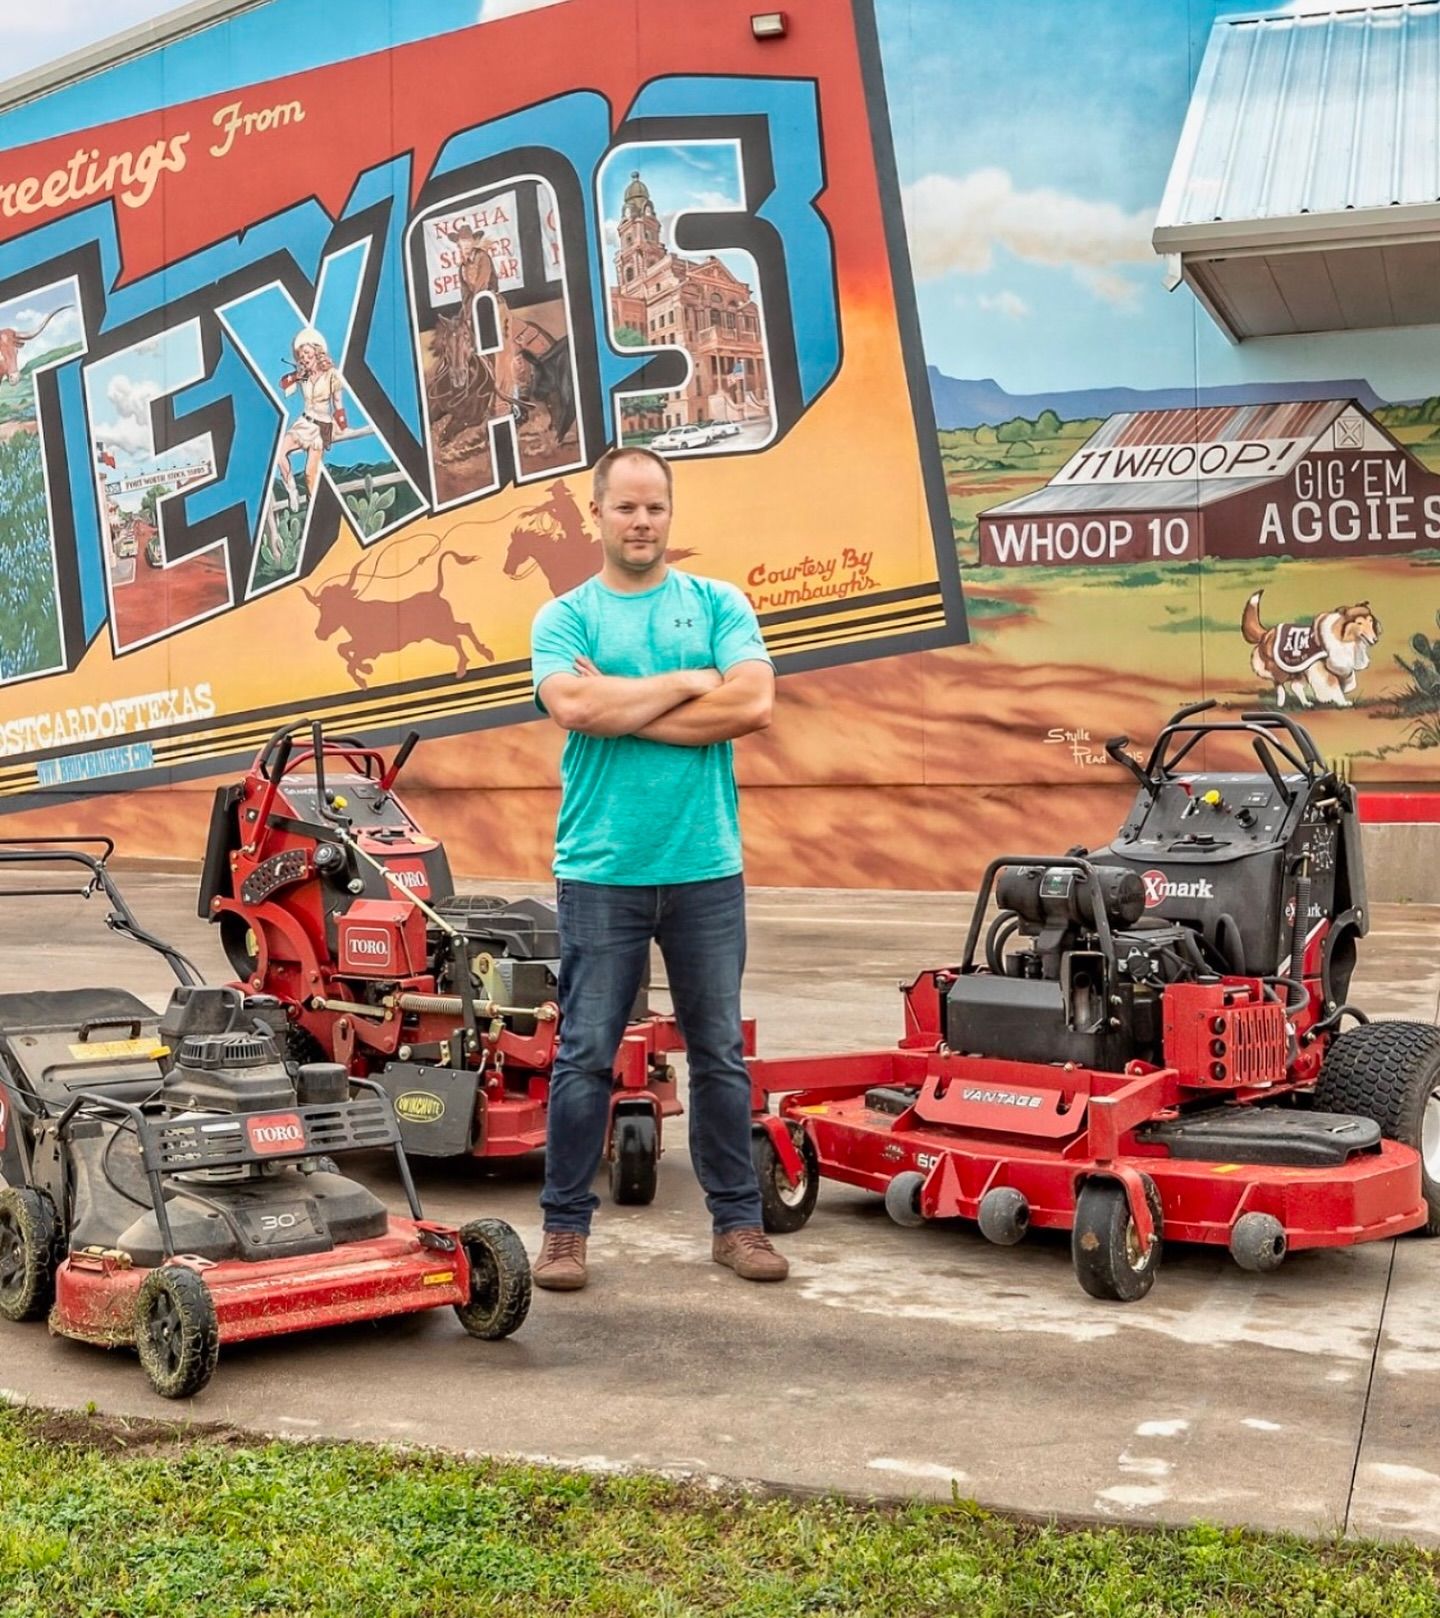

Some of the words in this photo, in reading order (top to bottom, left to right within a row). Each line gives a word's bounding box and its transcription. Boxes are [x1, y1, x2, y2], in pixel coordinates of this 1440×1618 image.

[210, 101, 305, 157] From
[989, 520, 1132, 562] WHOOP
[1148, 517, 1189, 556] 10
[747, 556, 837, 587] Courtesy
[842, 548, 873, 575] By
[1143, 876, 1214, 901] Xmark
[349, 938, 386, 955] TORO
[962, 1088, 1042, 1108] VANTAGE
[253, 1125, 300, 1143] TORO
